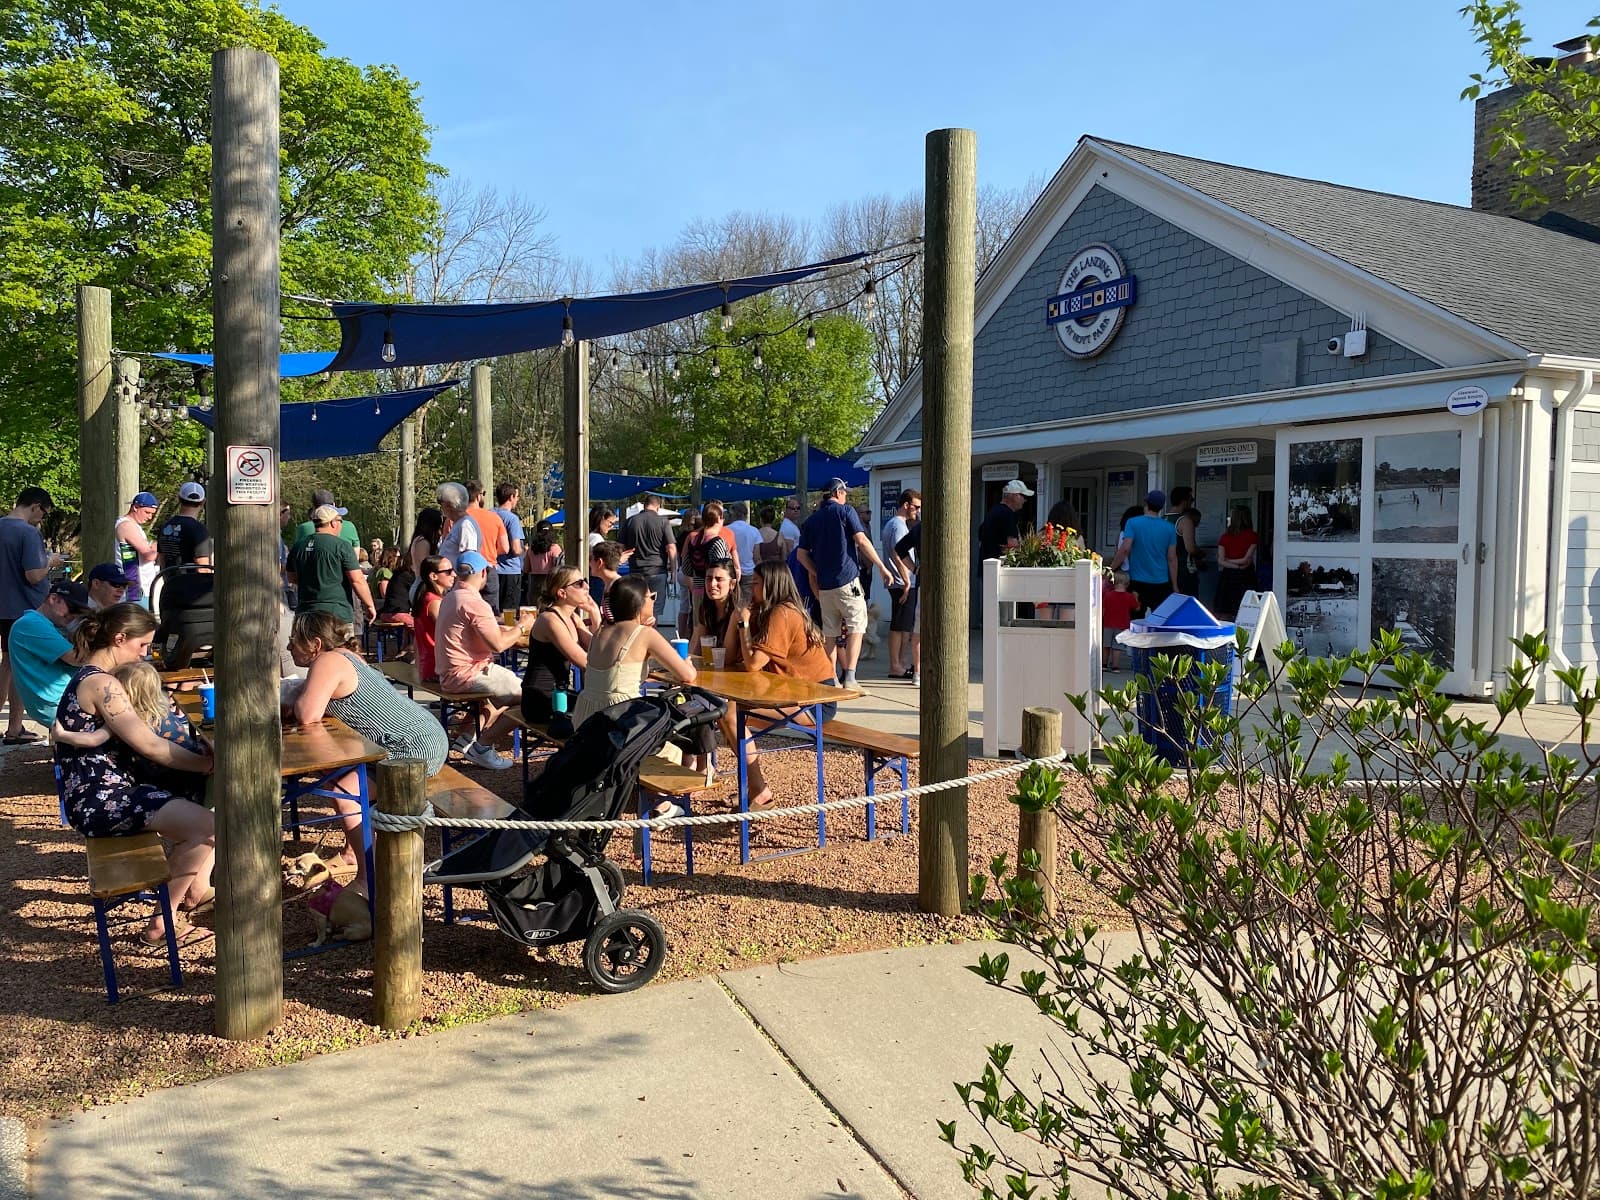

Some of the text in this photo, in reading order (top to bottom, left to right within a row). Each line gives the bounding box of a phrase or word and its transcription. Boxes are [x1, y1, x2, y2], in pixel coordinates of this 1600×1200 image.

[1065, 256, 1112, 288] THE LANDING
[1092, 317, 1110, 341] PARK
[1199, 446, 1237, 455] BEVERAGES
[1237, 443, 1256, 452] ONLY
